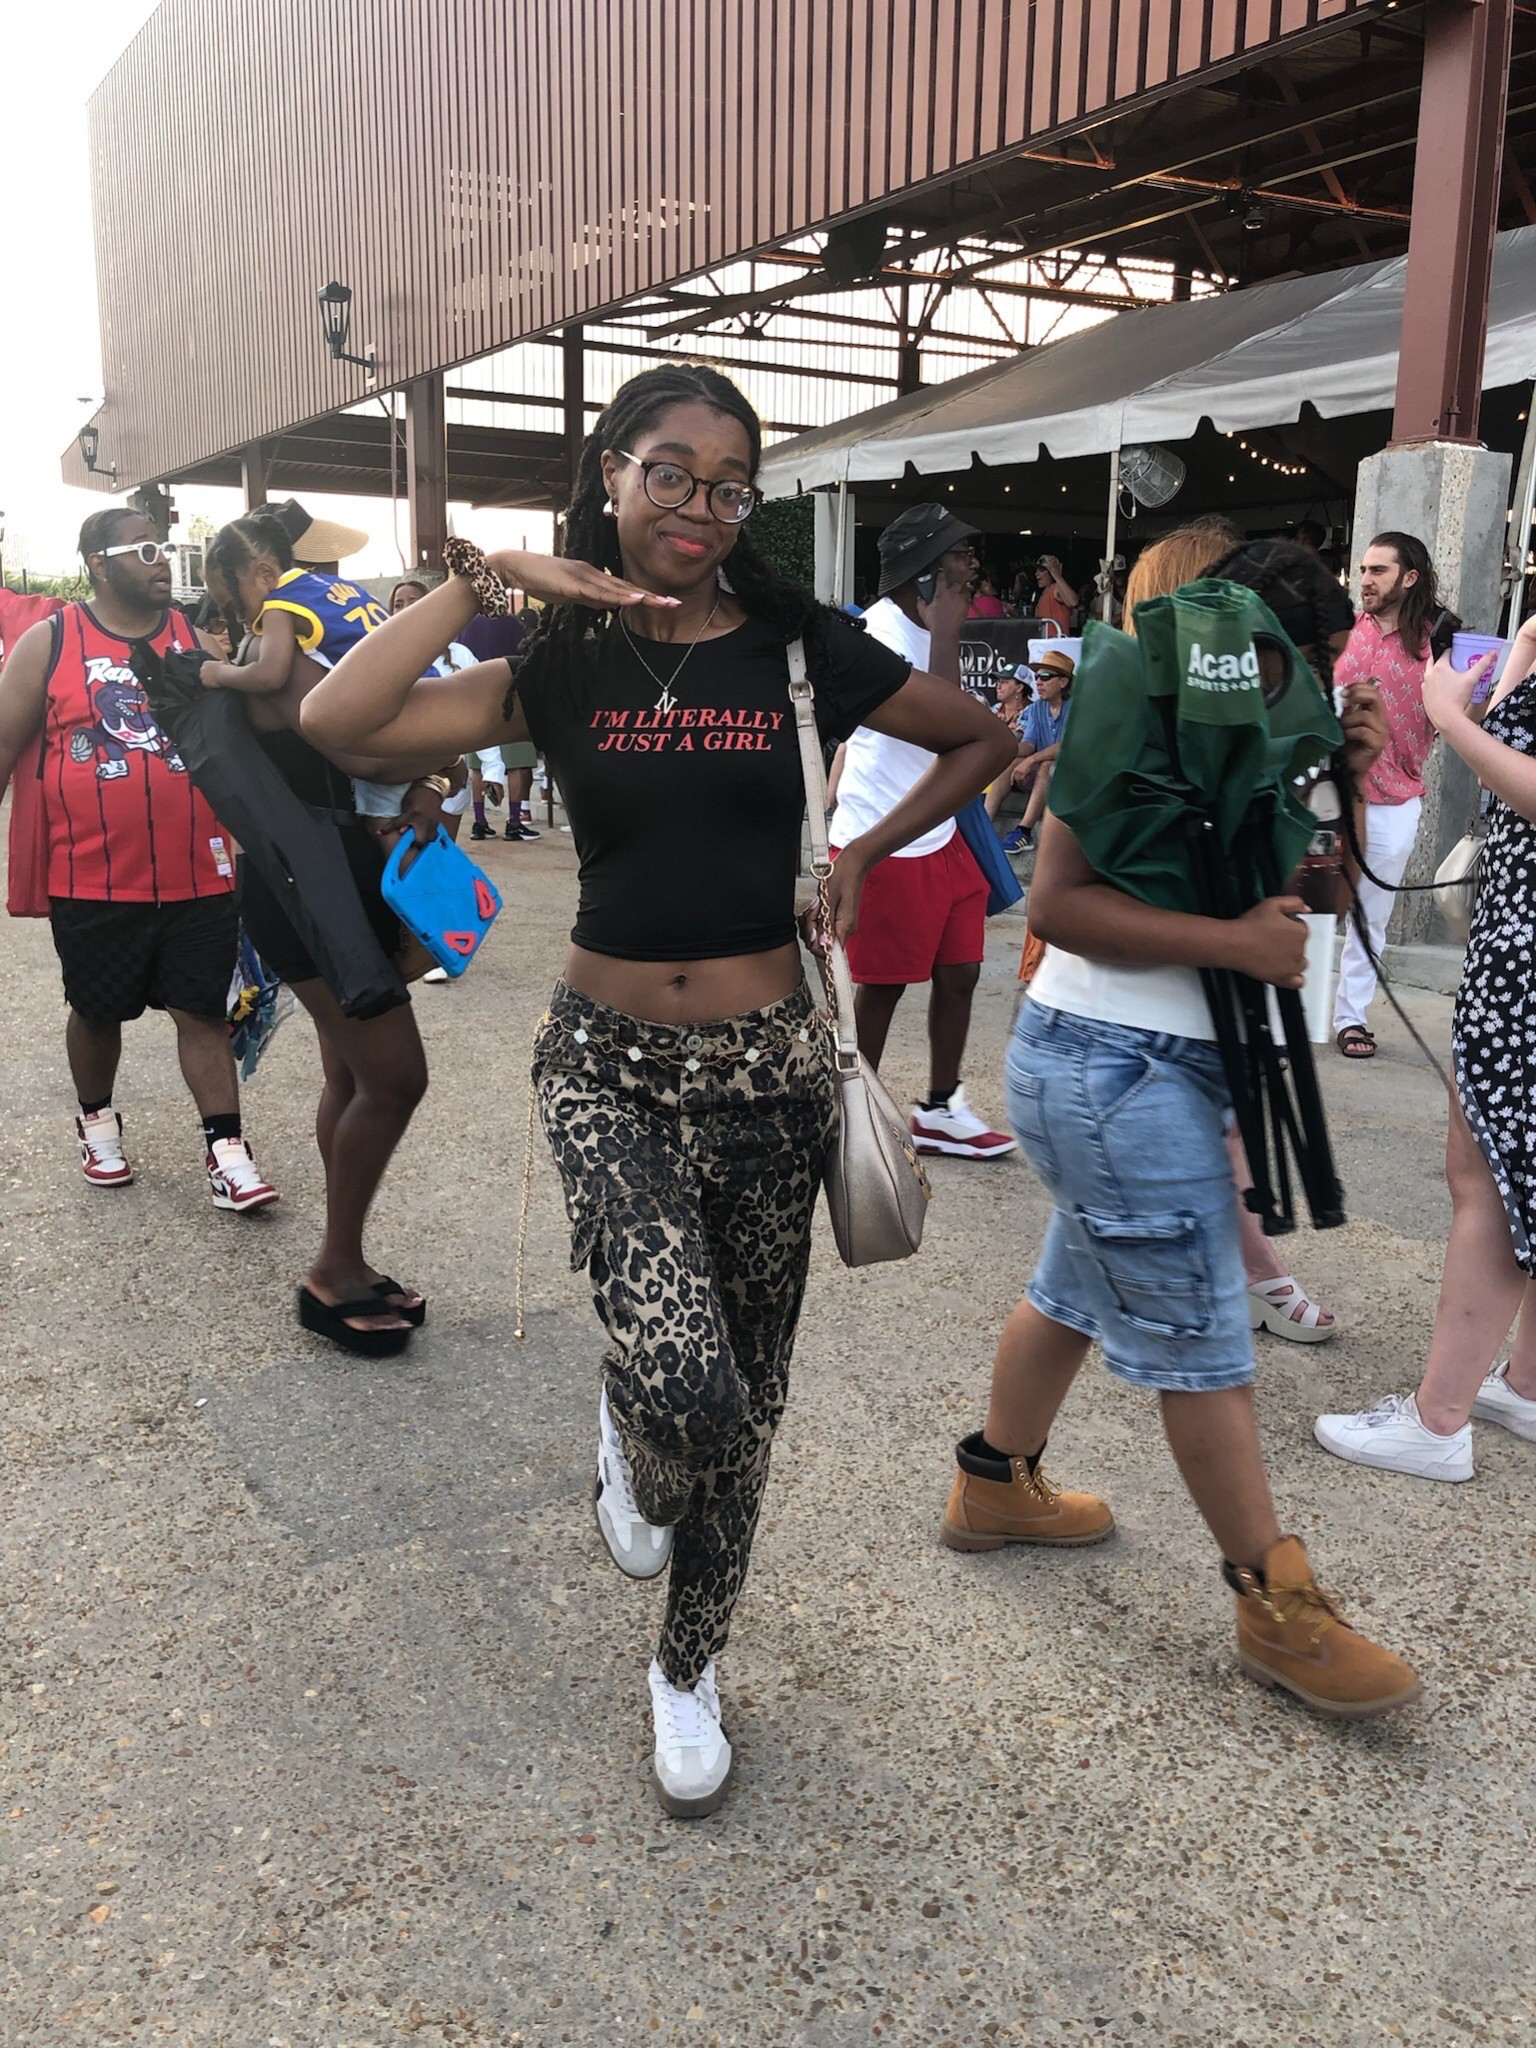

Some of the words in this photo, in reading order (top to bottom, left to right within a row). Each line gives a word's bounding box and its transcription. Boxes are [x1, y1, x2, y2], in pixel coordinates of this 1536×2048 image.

[1187, 641, 1259, 680] Acad
[589, 710, 630, 728] I'M
[633, 708, 784, 730] LITERALLY
[597, 733, 671, 752] JUST
[674, 732, 695, 751] A
[703, 731, 772, 751] GIRL
